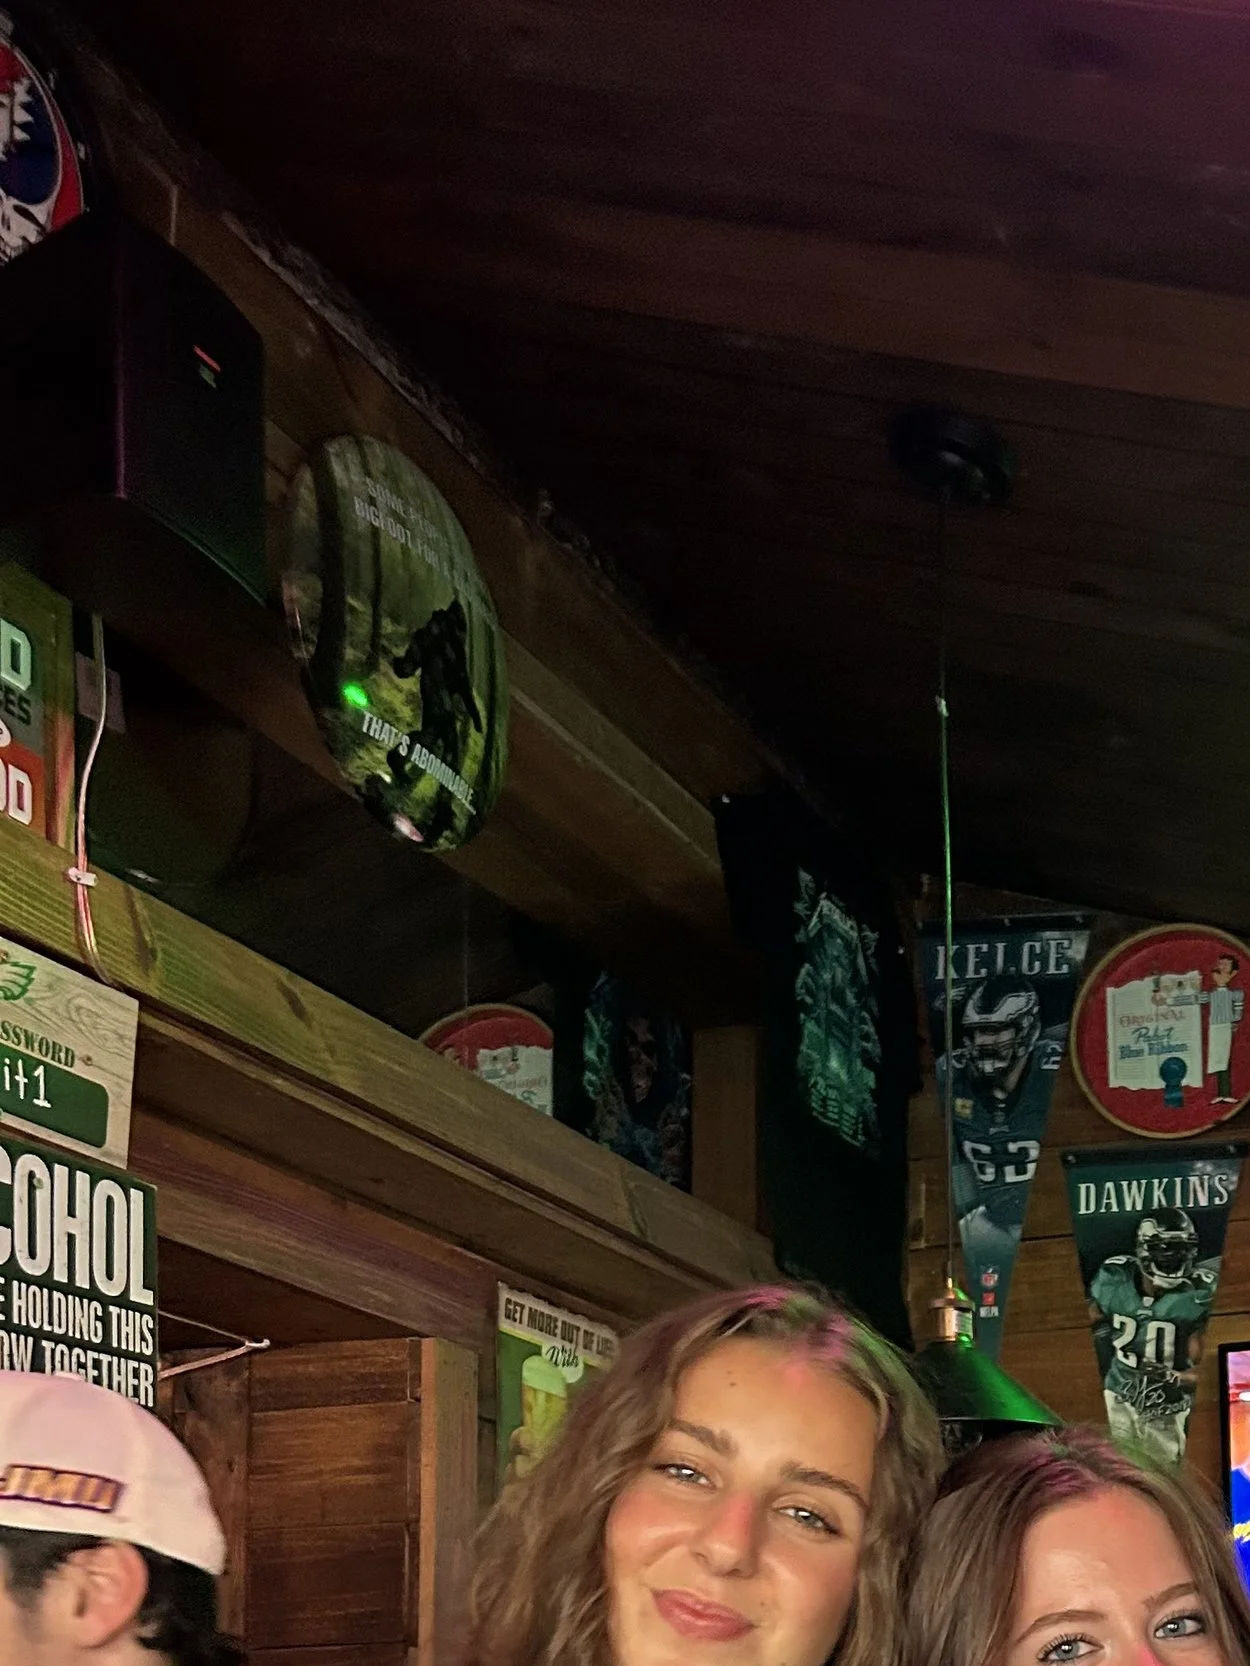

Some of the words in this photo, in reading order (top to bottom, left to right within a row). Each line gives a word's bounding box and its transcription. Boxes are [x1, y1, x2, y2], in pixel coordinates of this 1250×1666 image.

[0, 686, 32, 726] ES
[362, 709, 410, 757] THAT'S
[935, 938, 1071, 980] KELCE
[0, 1020, 75, 1068] SSWORD
[1078, 1174, 1229, 1215] DAWKINS
[12, 1279, 103, 1344] HOLDING
[109, 1305, 154, 1356] THIS
[504, 1297, 525, 1324] GET
[527, 1306, 558, 1338] MORE
[1112, 1313, 1176, 1370] 20
[42, 1339, 154, 1408] TOGETHER
